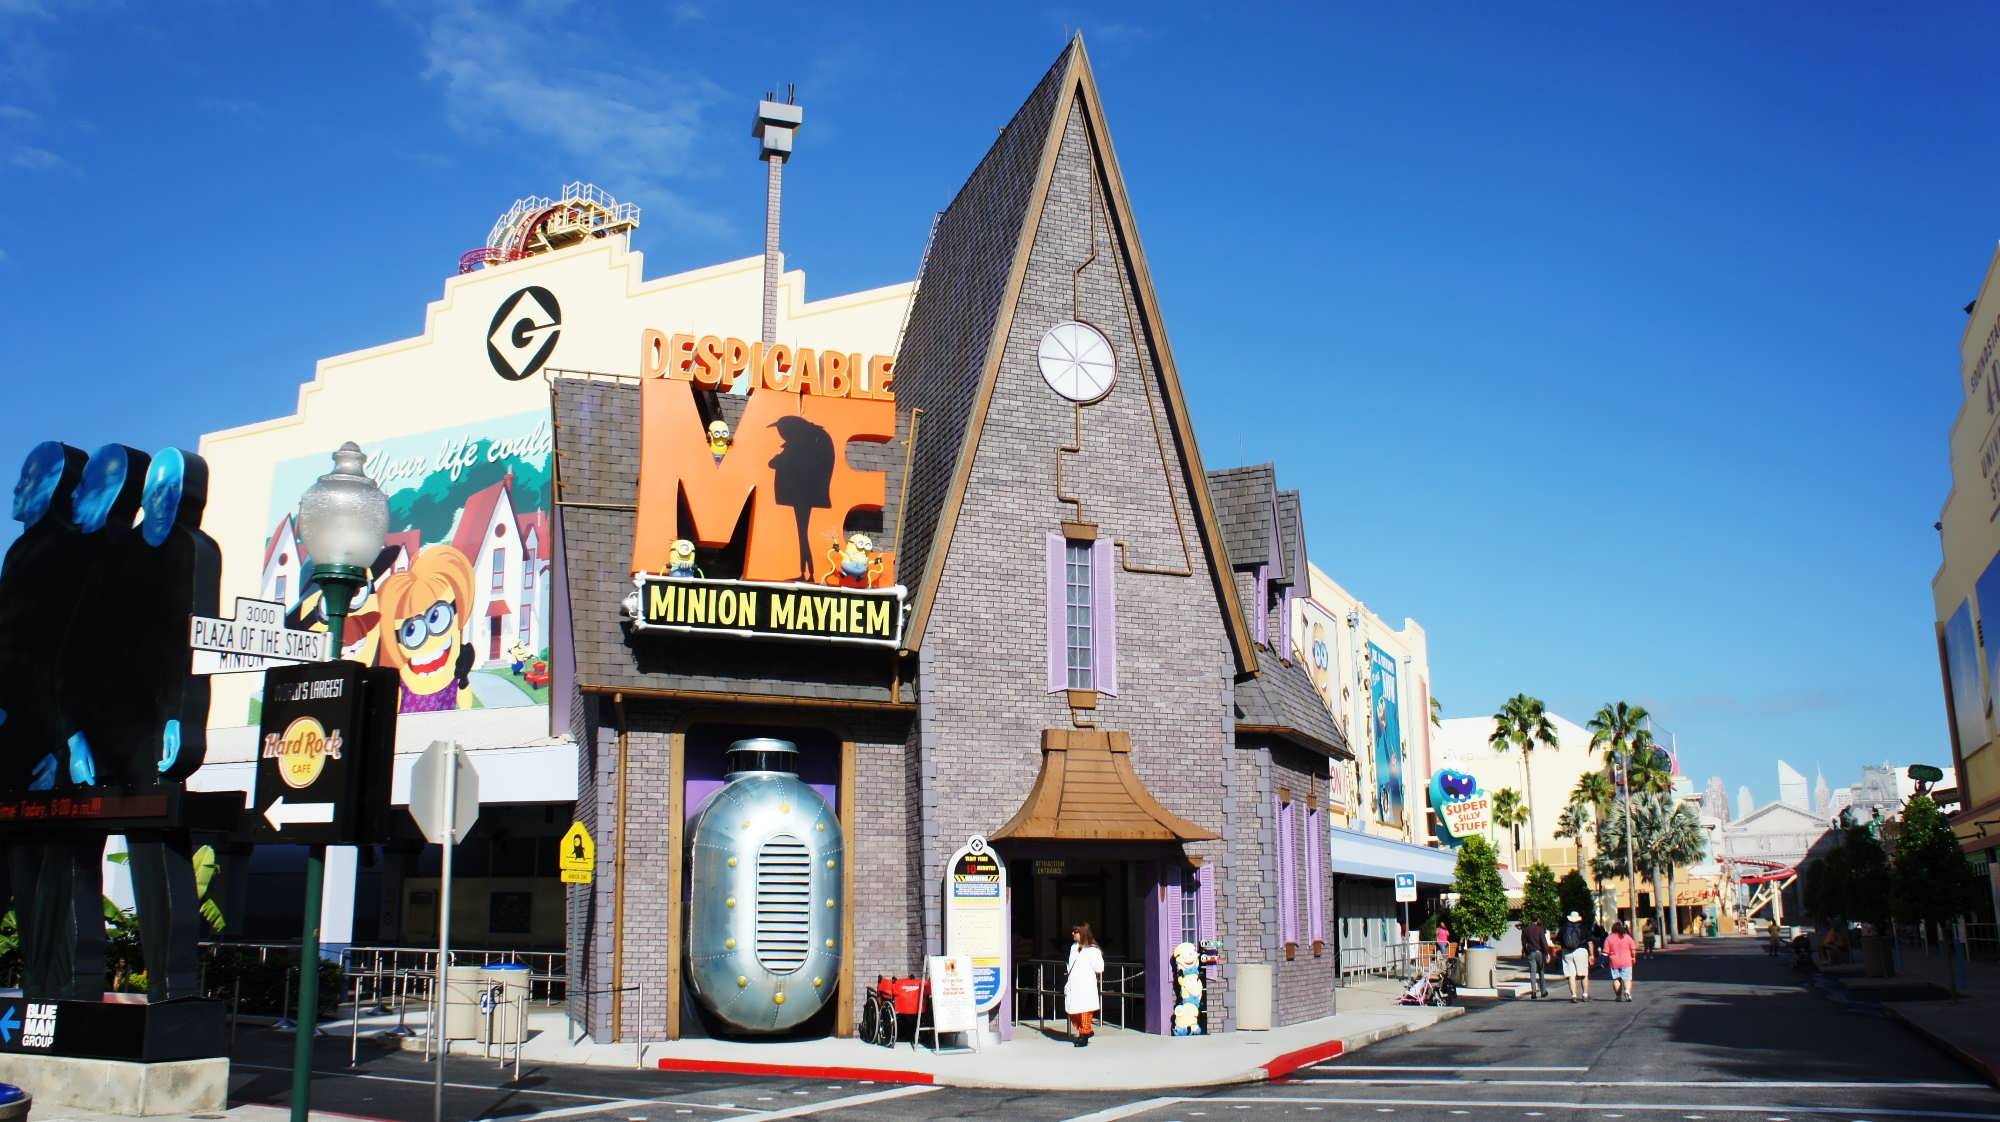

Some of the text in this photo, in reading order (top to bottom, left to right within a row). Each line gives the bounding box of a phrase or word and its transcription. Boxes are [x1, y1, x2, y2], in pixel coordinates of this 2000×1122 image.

[641, 328, 896, 401] DESPICABLE
[363, 447, 428, 488] Your
[434, 432, 480, 482] life
[631, 377, 897, 589] ME
[247, 606, 276, 624] 3000
[649, 584, 891, 636] MINION MAYHEM
[195, 620, 318, 659] PLAZA OF THE STARS
[219, 653, 264, 669] MINION
[310, 679, 344, 699] LARGEST
[263, 729, 343, 760] Hard Rock
[293, 764, 311, 774] CAFE
[1446, 799, 1487, 815] SUPER
[1458, 811, 1480, 822] SILLY
[1453, 821, 1487, 833] STUFF
[26, 1003, 58, 1019] BLUE
[24, 1018, 56, 1036] MAN
[22, 1035, 54, 1048] GROUP
